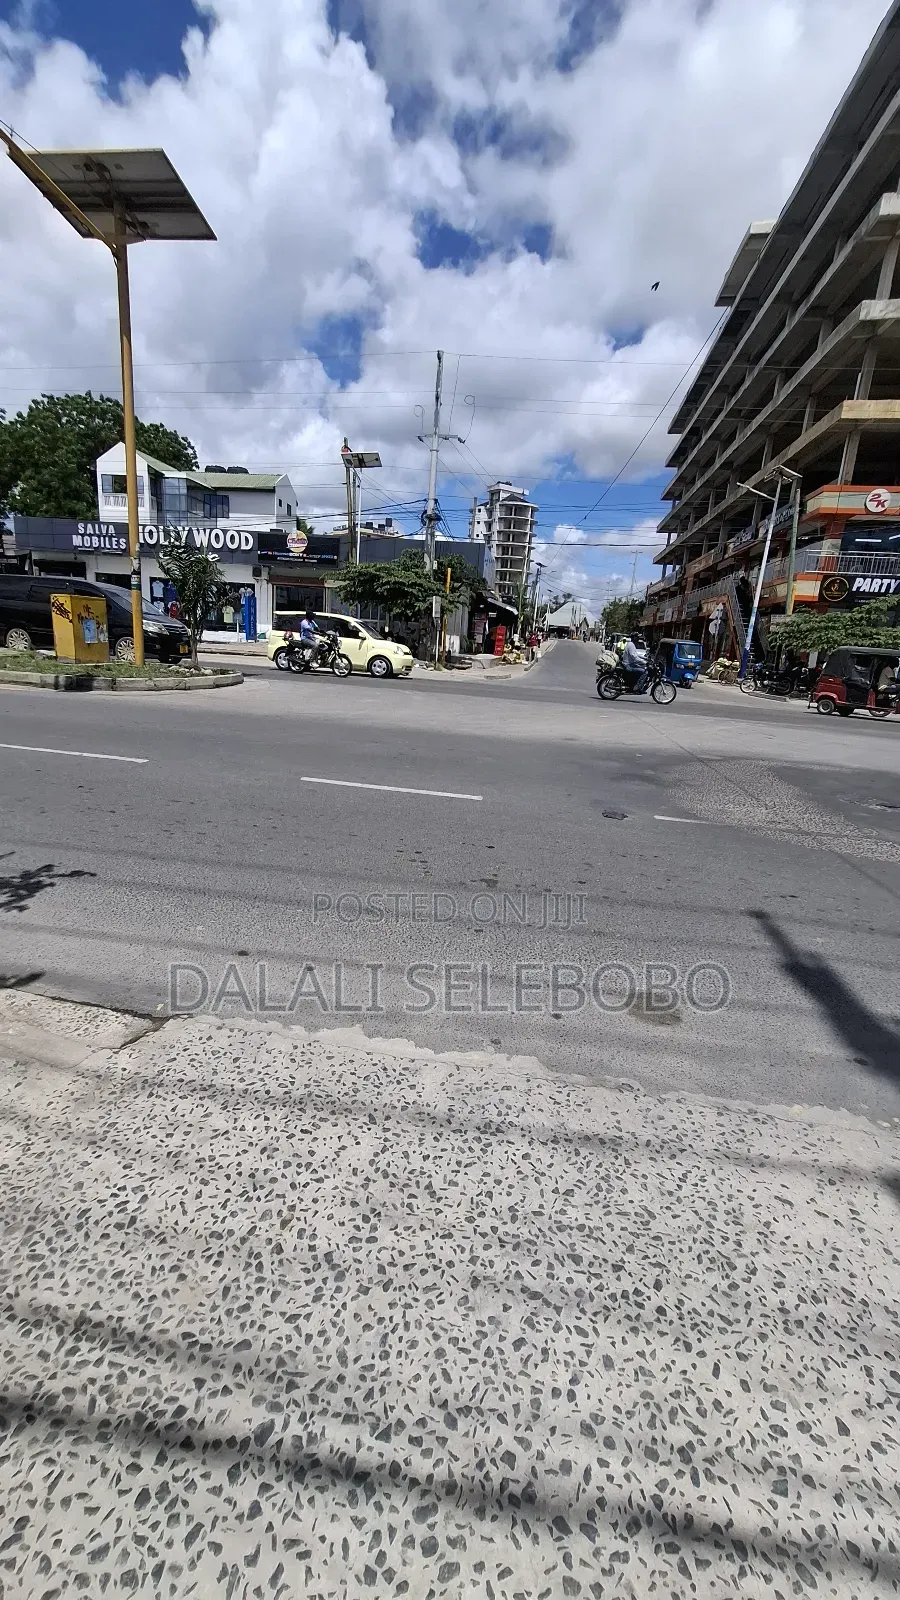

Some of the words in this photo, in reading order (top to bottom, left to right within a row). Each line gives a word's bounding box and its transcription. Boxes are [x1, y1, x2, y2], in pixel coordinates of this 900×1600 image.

[868, 493, 889, 508] 2K
[77, 522, 116, 536] SALVA
[72, 535, 127, 550] MOBILES
[851, 577, 900, 593] PARTY
